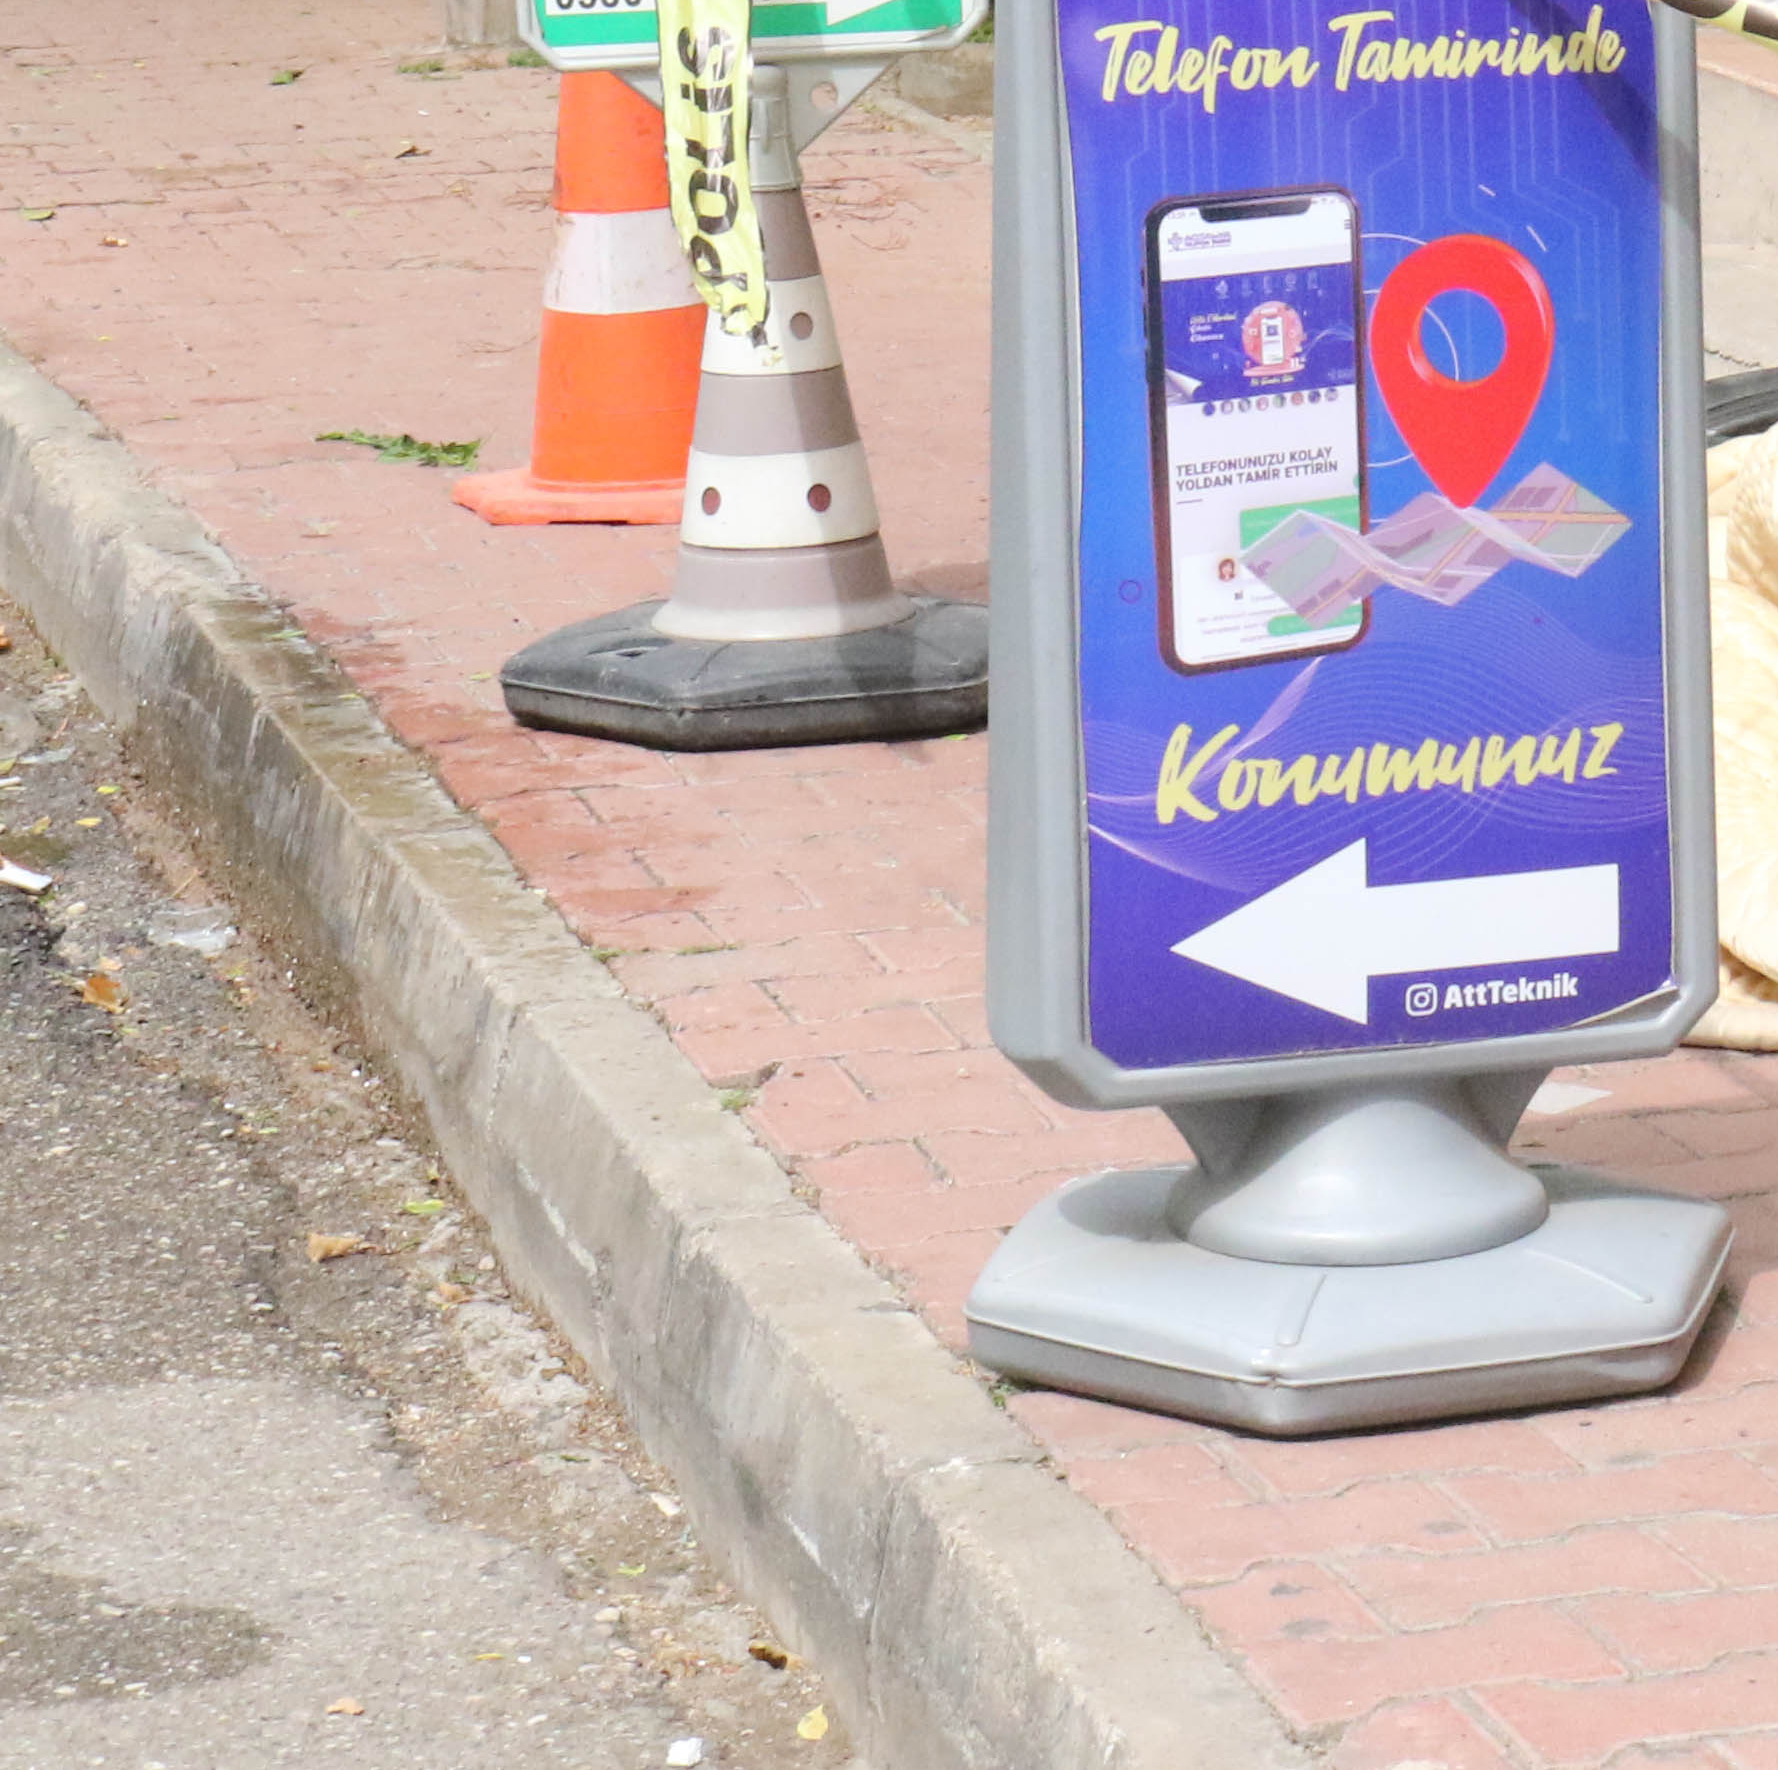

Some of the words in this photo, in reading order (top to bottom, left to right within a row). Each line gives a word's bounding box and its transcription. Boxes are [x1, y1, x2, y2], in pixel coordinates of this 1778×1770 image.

[1094, 20, 1320, 114] Telefon
[1328, 4, 1627, 91] Tamirinde
[1176, 453, 1285, 477] TELEFONUNUZU
[1289, 446, 1333, 463] KOLAY
[1176, 474, 1233, 492] YOLDAN
[1156, 722, 1624, 824] Konumunuz
[1443, 972, 1579, 1009] AttTeknik
